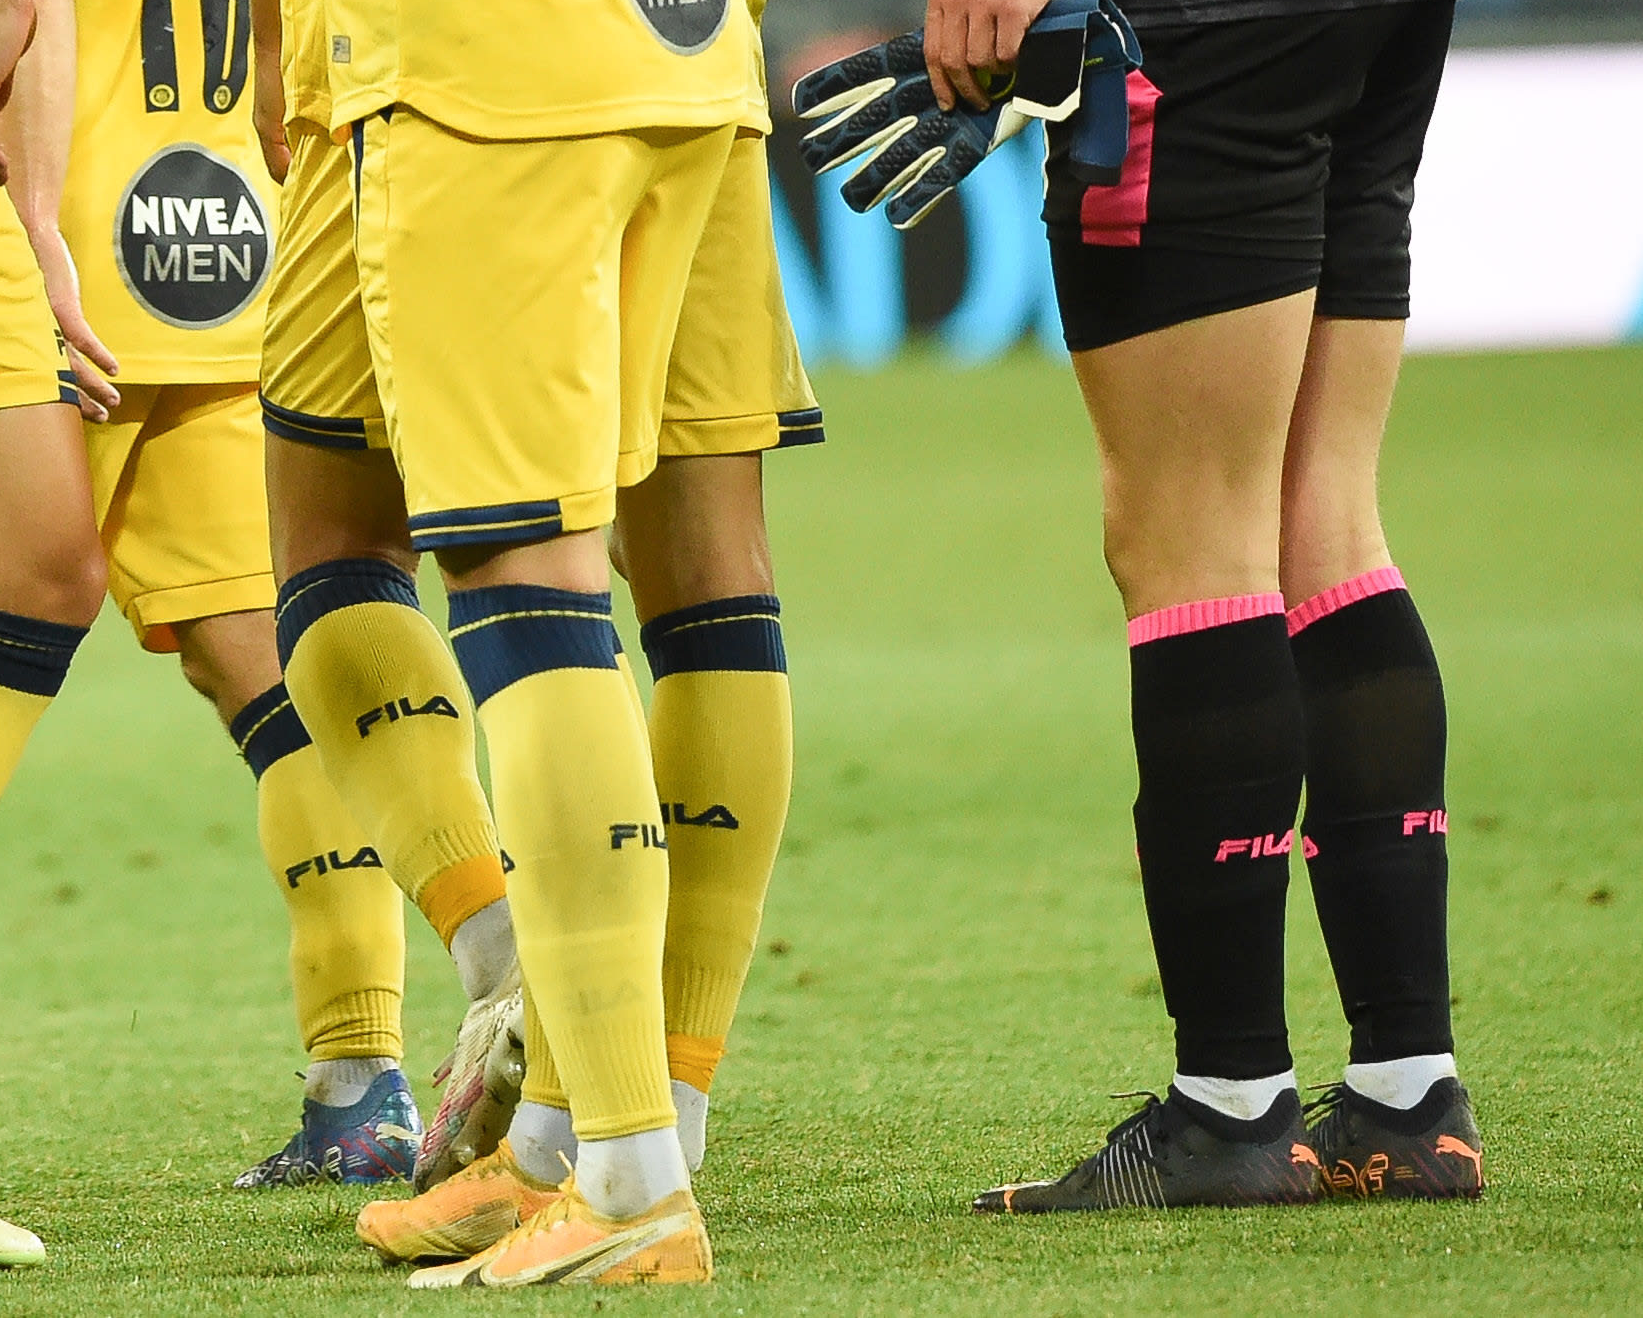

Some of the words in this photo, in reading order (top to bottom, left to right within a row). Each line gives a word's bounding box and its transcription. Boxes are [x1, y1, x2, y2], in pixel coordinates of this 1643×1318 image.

[132, 193, 266, 237] NIVEA
[143, 242, 252, 283] MEN
[356, 695, 460, 739] FILA
[609, 823, 668, 850] FIL
[661, 802, 739, 830] ILA
[1403, 809, 1448, 837] FIL
[286, 845, 384, 890] FILA
